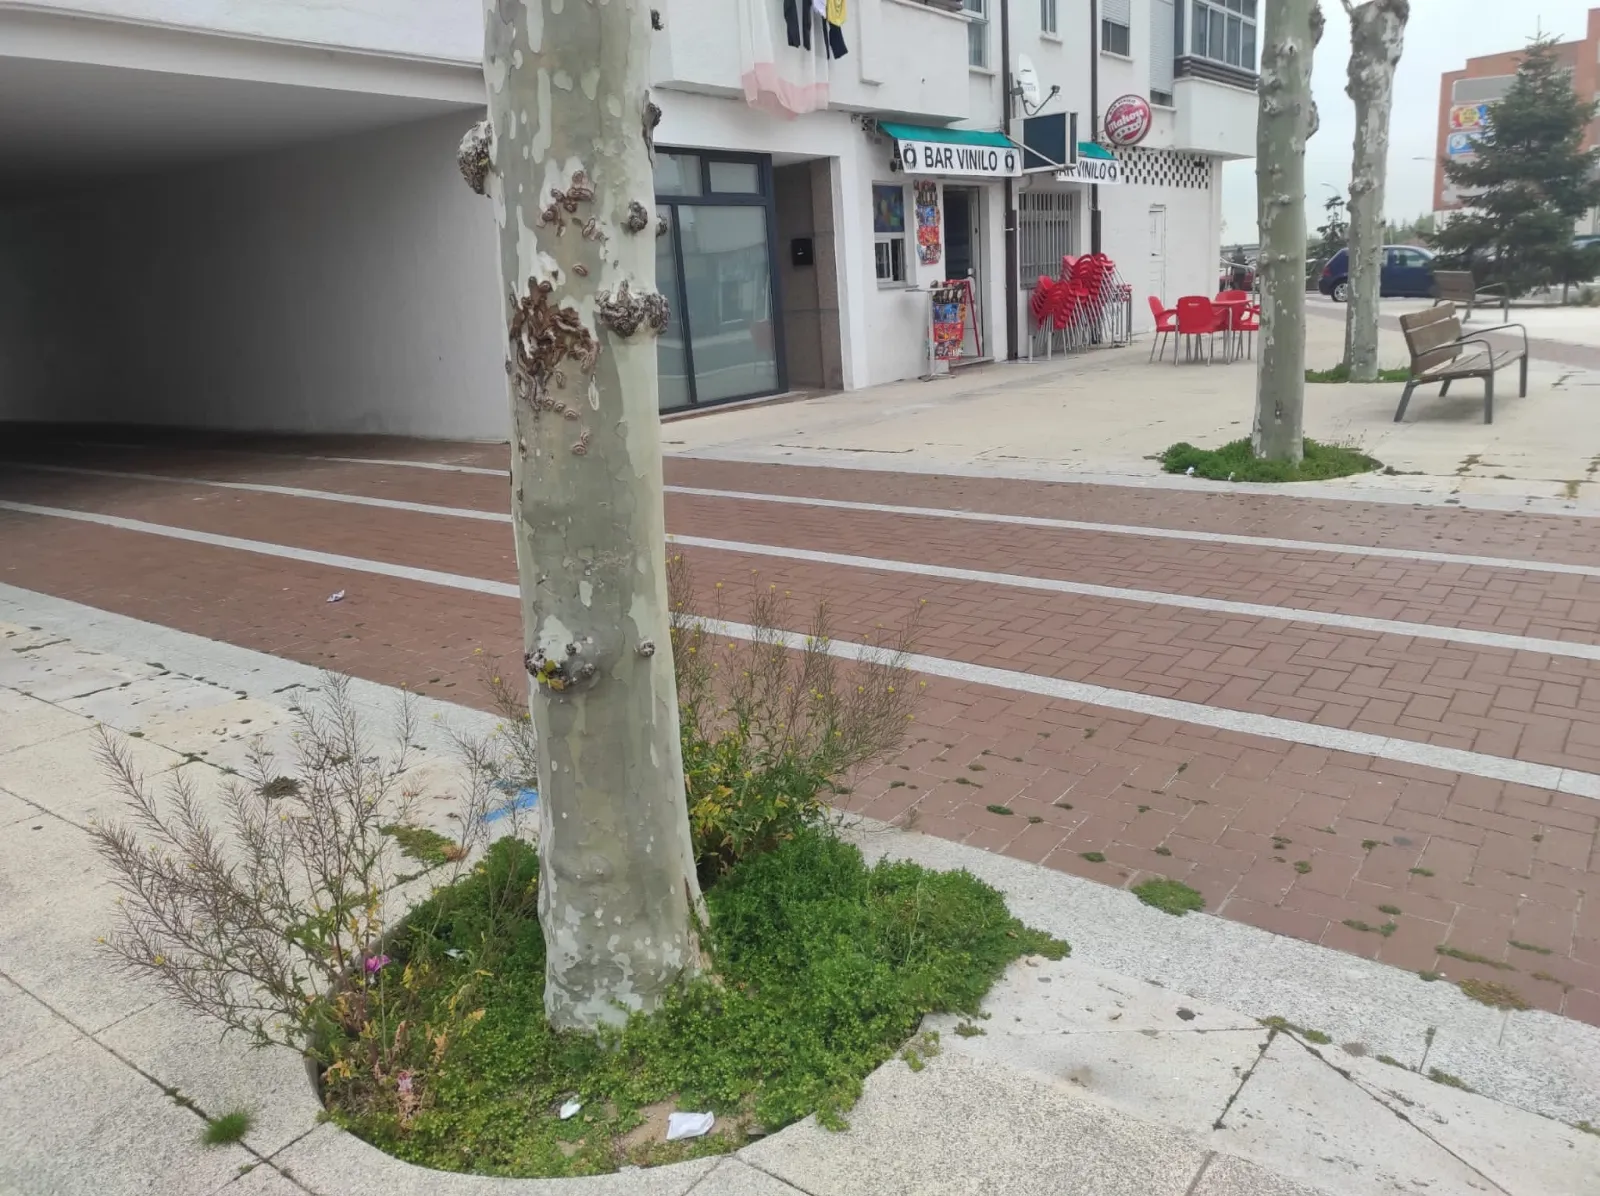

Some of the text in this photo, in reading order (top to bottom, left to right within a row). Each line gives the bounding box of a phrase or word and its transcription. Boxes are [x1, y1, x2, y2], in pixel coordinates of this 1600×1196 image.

[924, 146, 998, 171] BAR VINILO
[1076, 161, 1106, 179] VINILO
